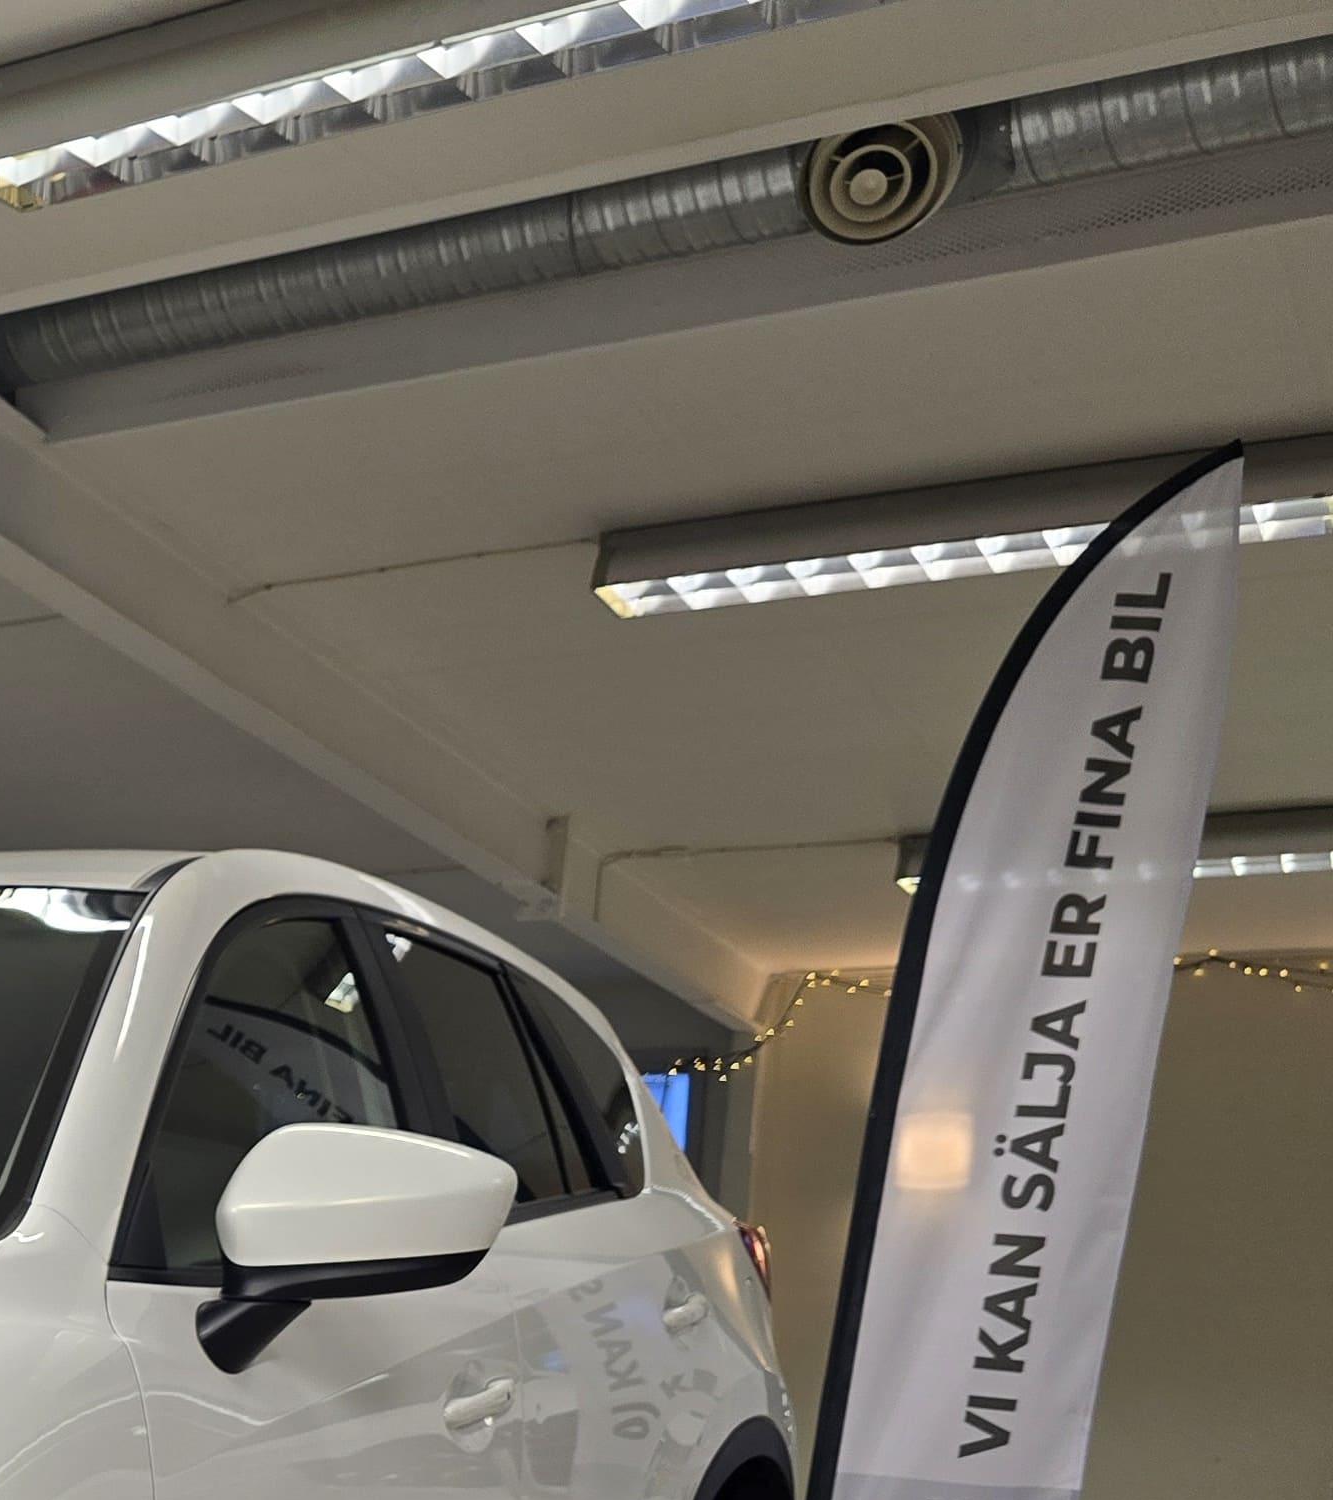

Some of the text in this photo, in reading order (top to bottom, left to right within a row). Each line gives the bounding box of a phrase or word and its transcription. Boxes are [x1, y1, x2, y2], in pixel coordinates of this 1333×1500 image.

[958, 572, 1172, 1458] VI KAN SÄLJA ER FINA BIL
